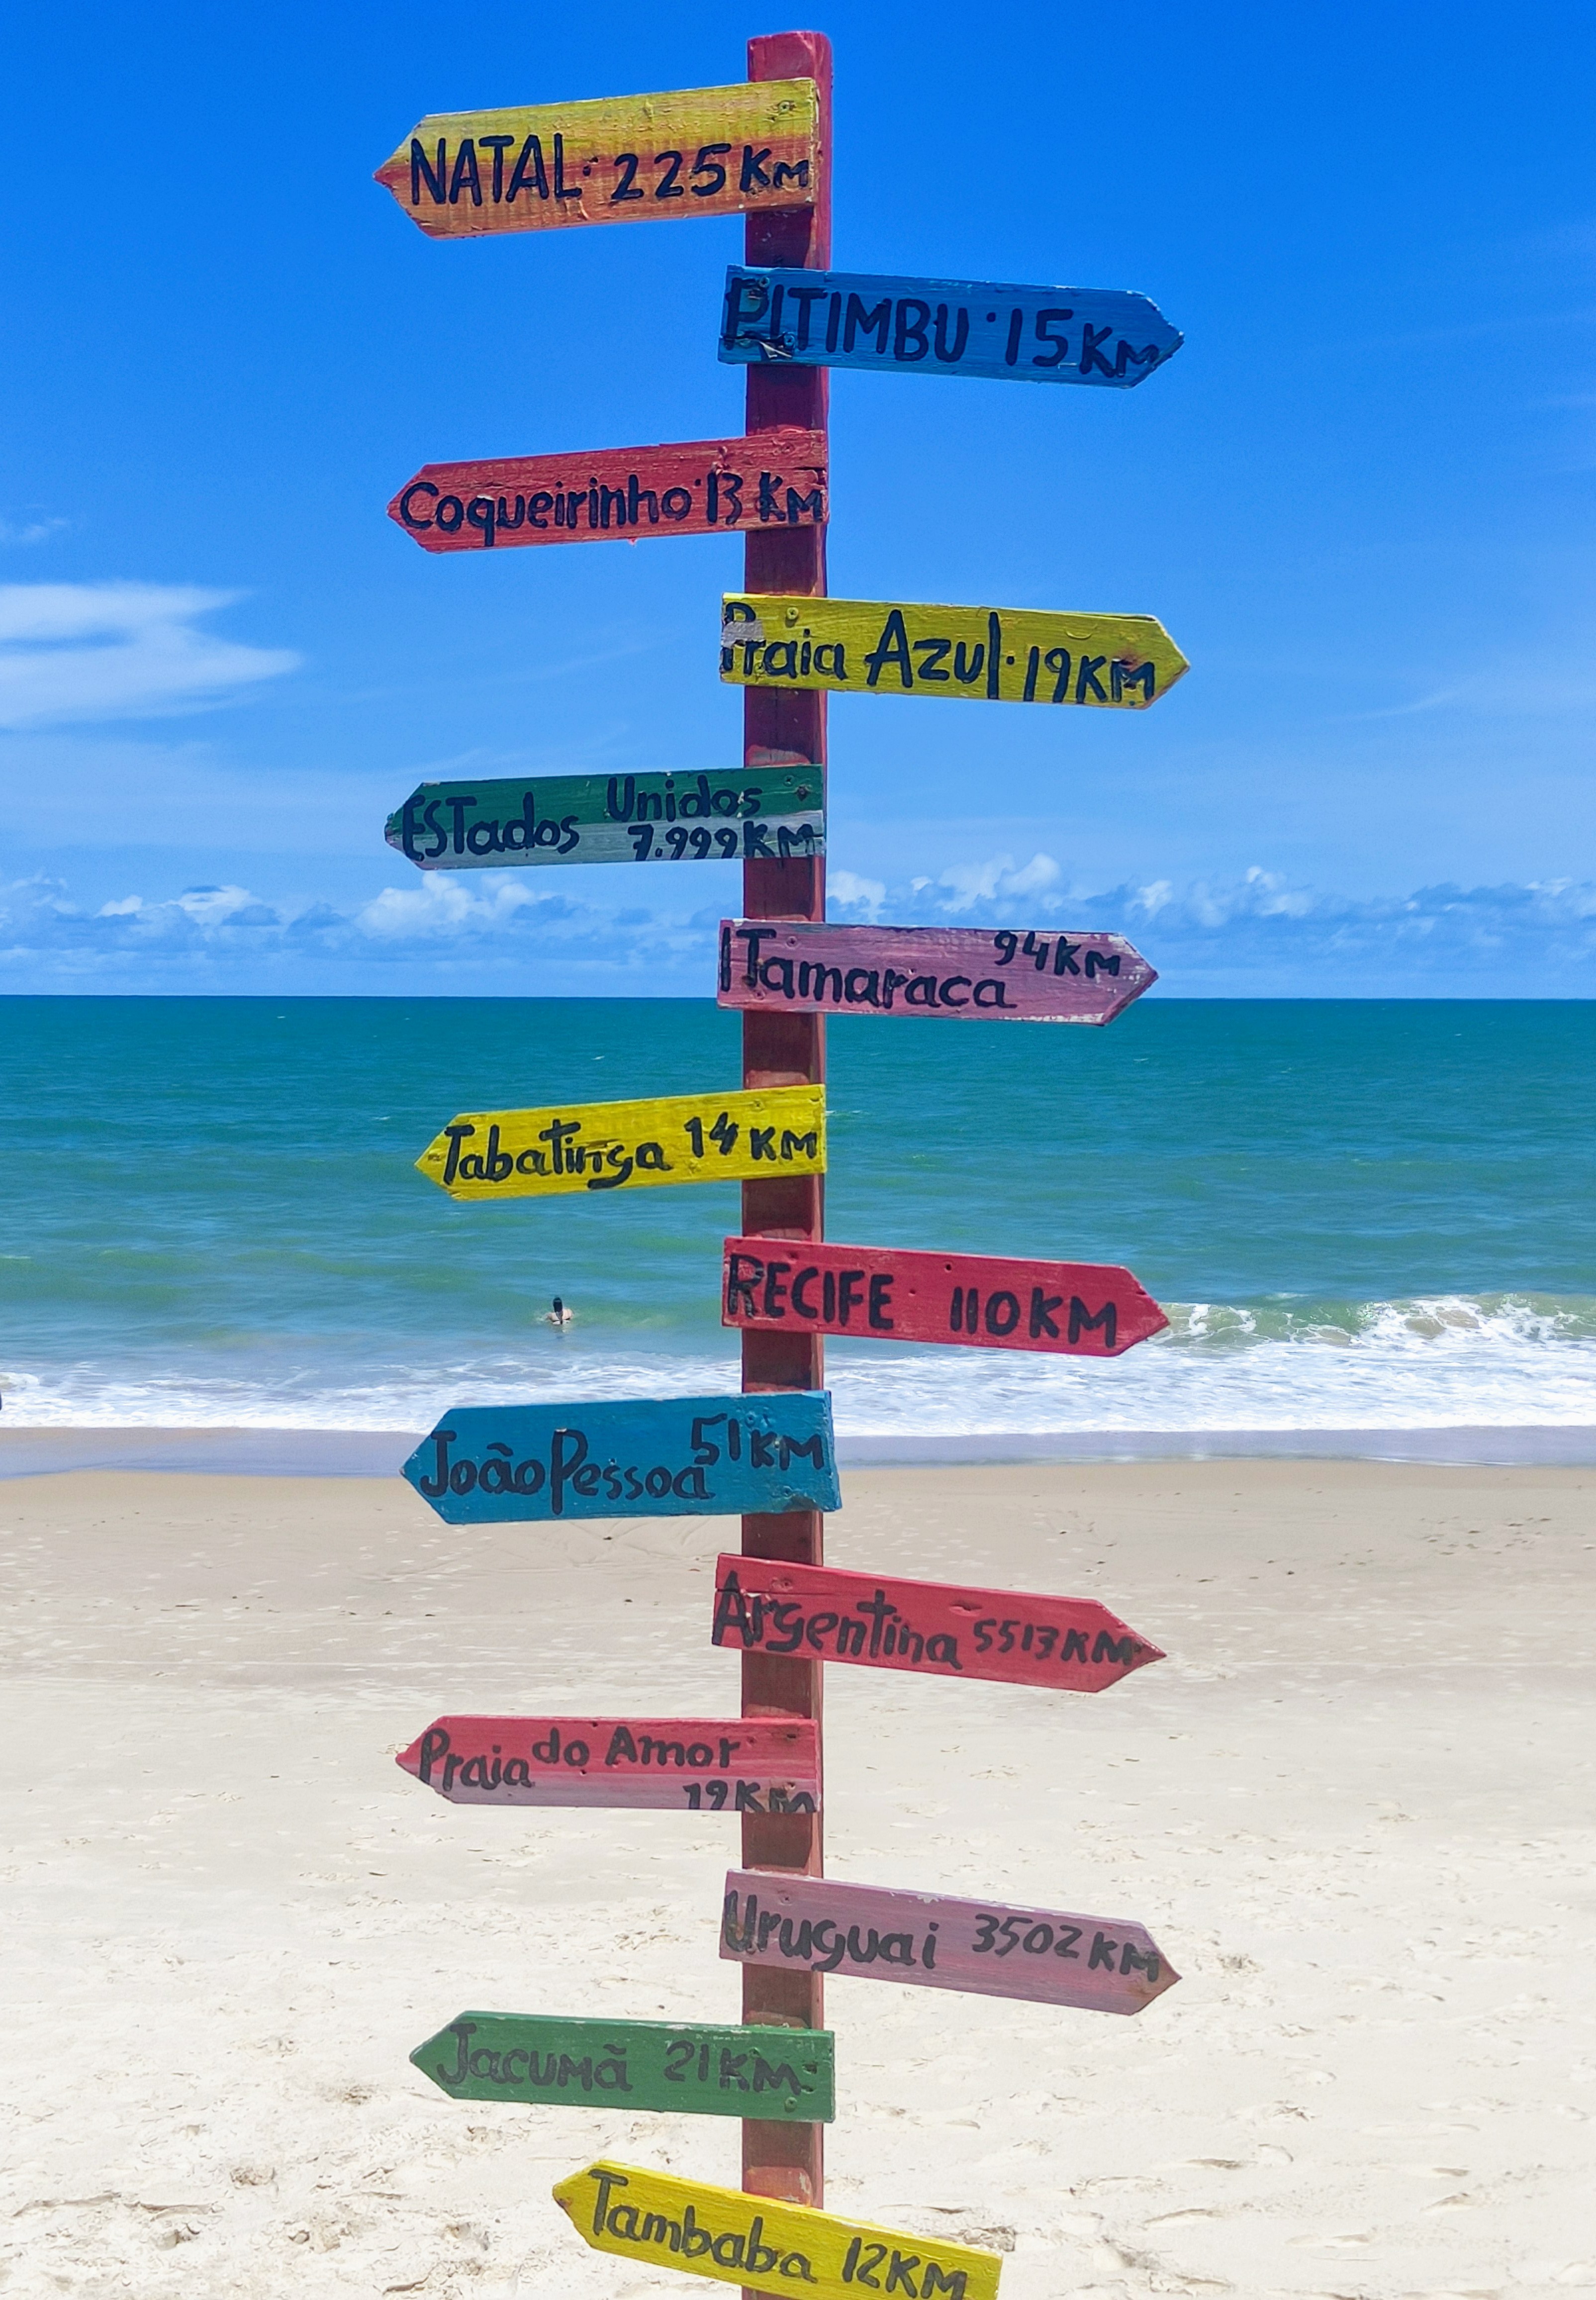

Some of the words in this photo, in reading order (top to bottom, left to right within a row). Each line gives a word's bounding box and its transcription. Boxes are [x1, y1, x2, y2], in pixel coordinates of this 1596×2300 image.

[722, 277, 969, 363] PITIMBU
[720, 602, 847, 680] Praia
[607, 775, 763, 823] Unidos
[728, 1253, 894, 1329] RECIFE
[420, 1430, 547, 1497] João
[550, 1428, 716, 1515] Pessoa
[712, 1570, 963, 1670] Argentina
[419, 1728, 534, 1791] Praia
[532, 1727, 591, 1767] do
[604, 1726, 741, 1768] Amor
[724, 1889, 939, 1972] Uruguai
[588, 2169, 819, 2284] Tambaba
